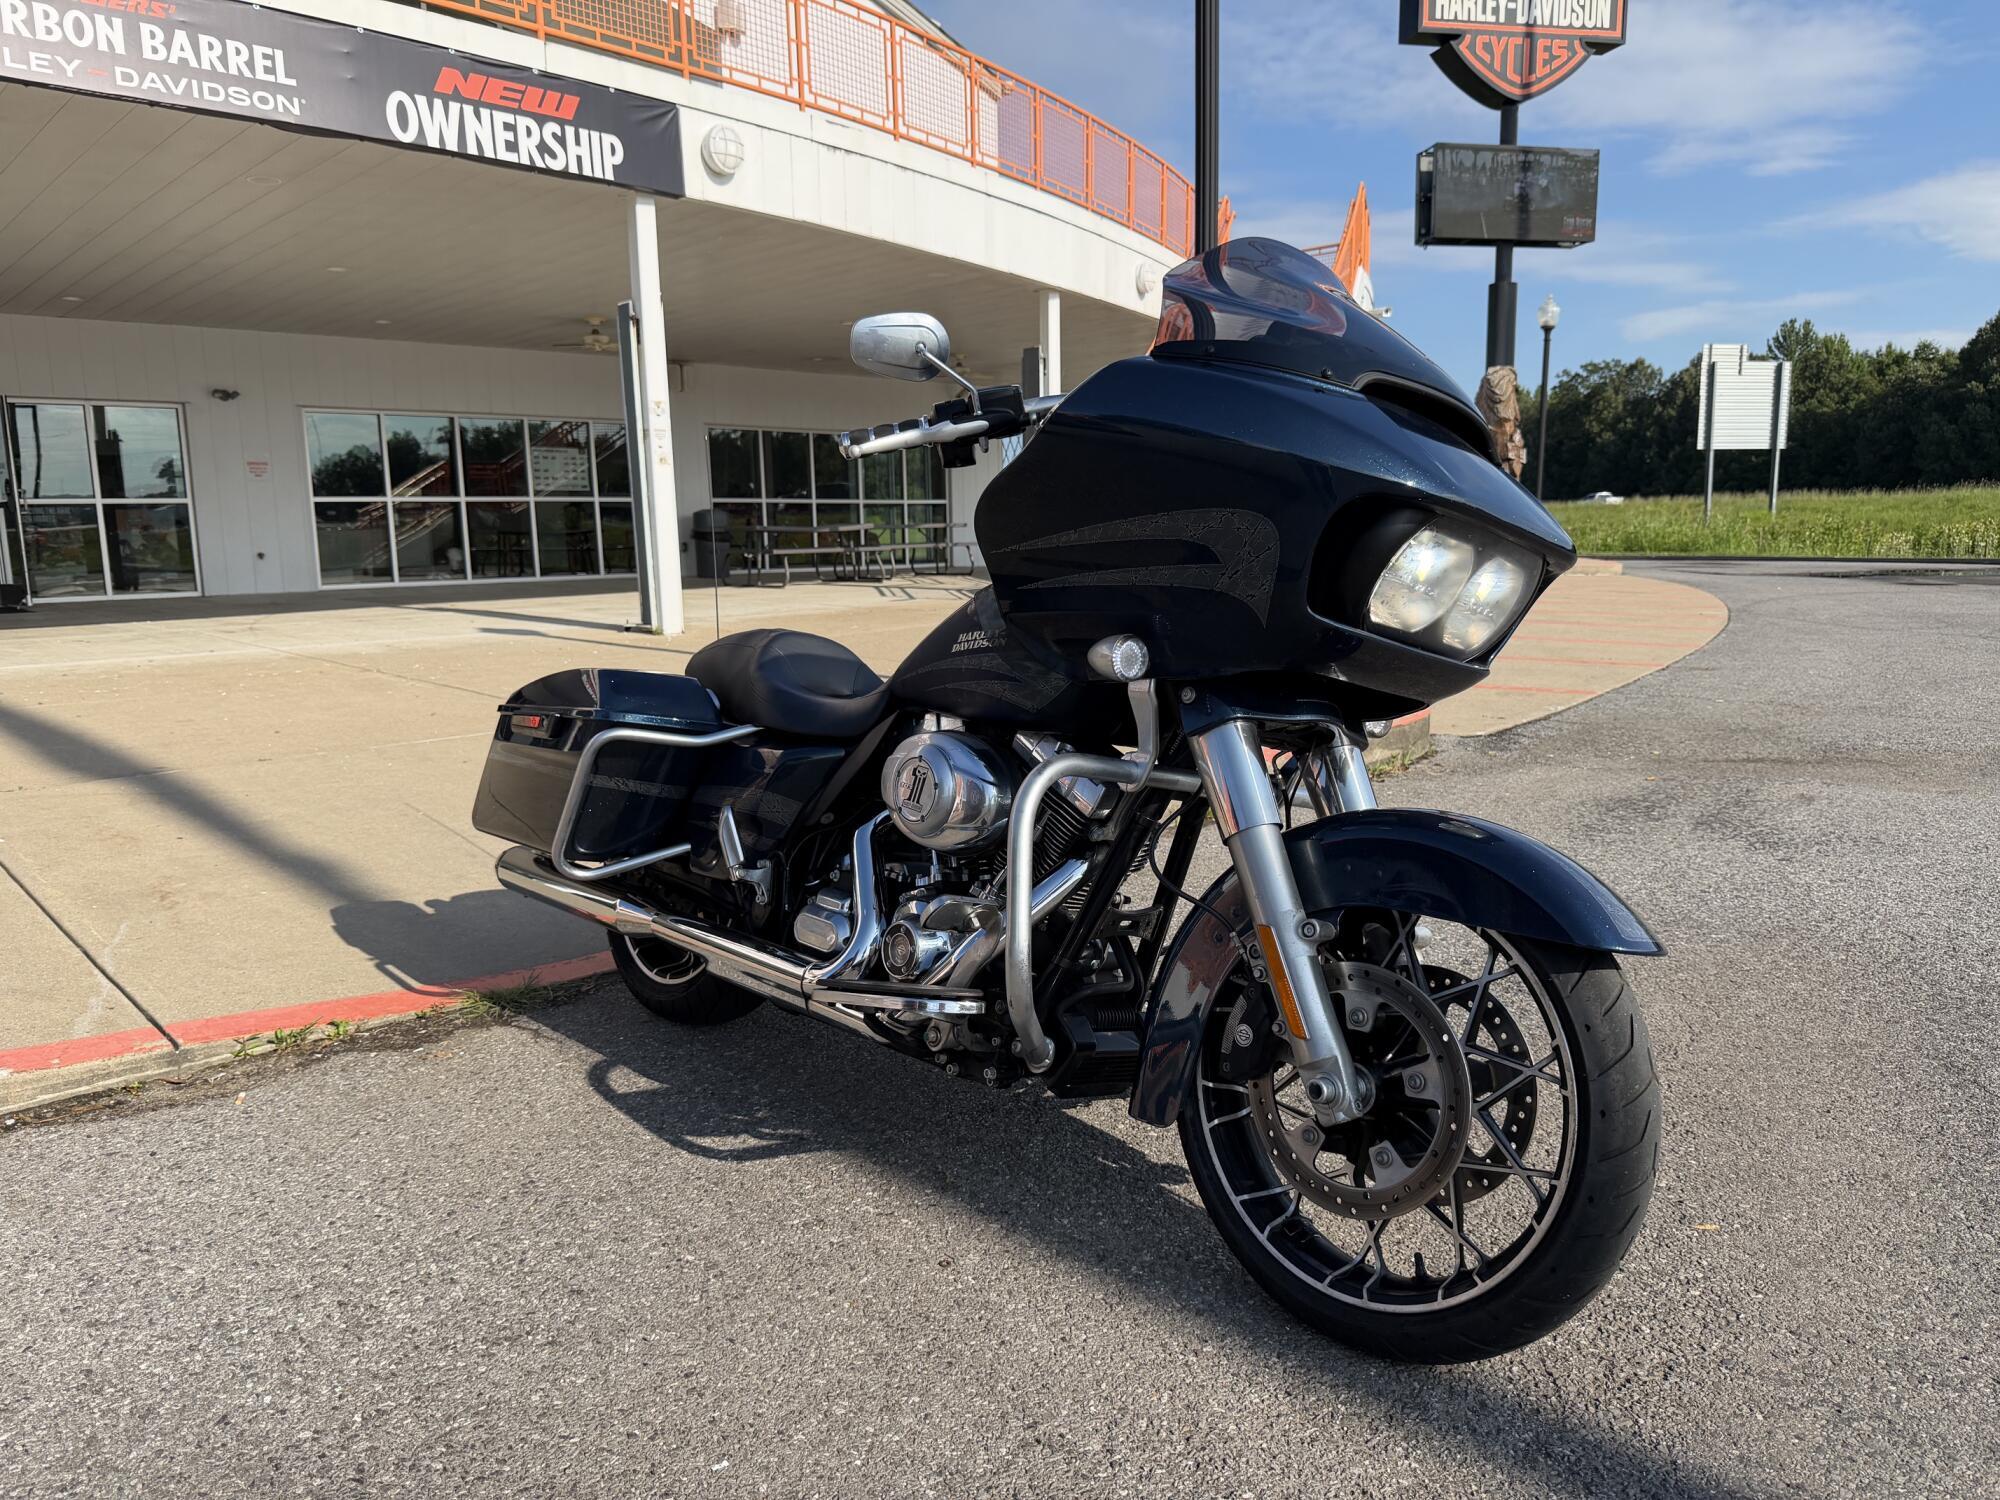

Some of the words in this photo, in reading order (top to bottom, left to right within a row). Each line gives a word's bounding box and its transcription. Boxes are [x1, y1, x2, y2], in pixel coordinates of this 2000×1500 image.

[1435, 0, 1611, 29] HARLEY-DAVIDSON
[0, 0, 126, 55] RBON
[139, 22, 297, 87] BARREL
[1475, 34, 1570, 84] CYCLES
[433, 67, 581, 121] NEW
[386, 90, 624, 181] OWNERSHIP
